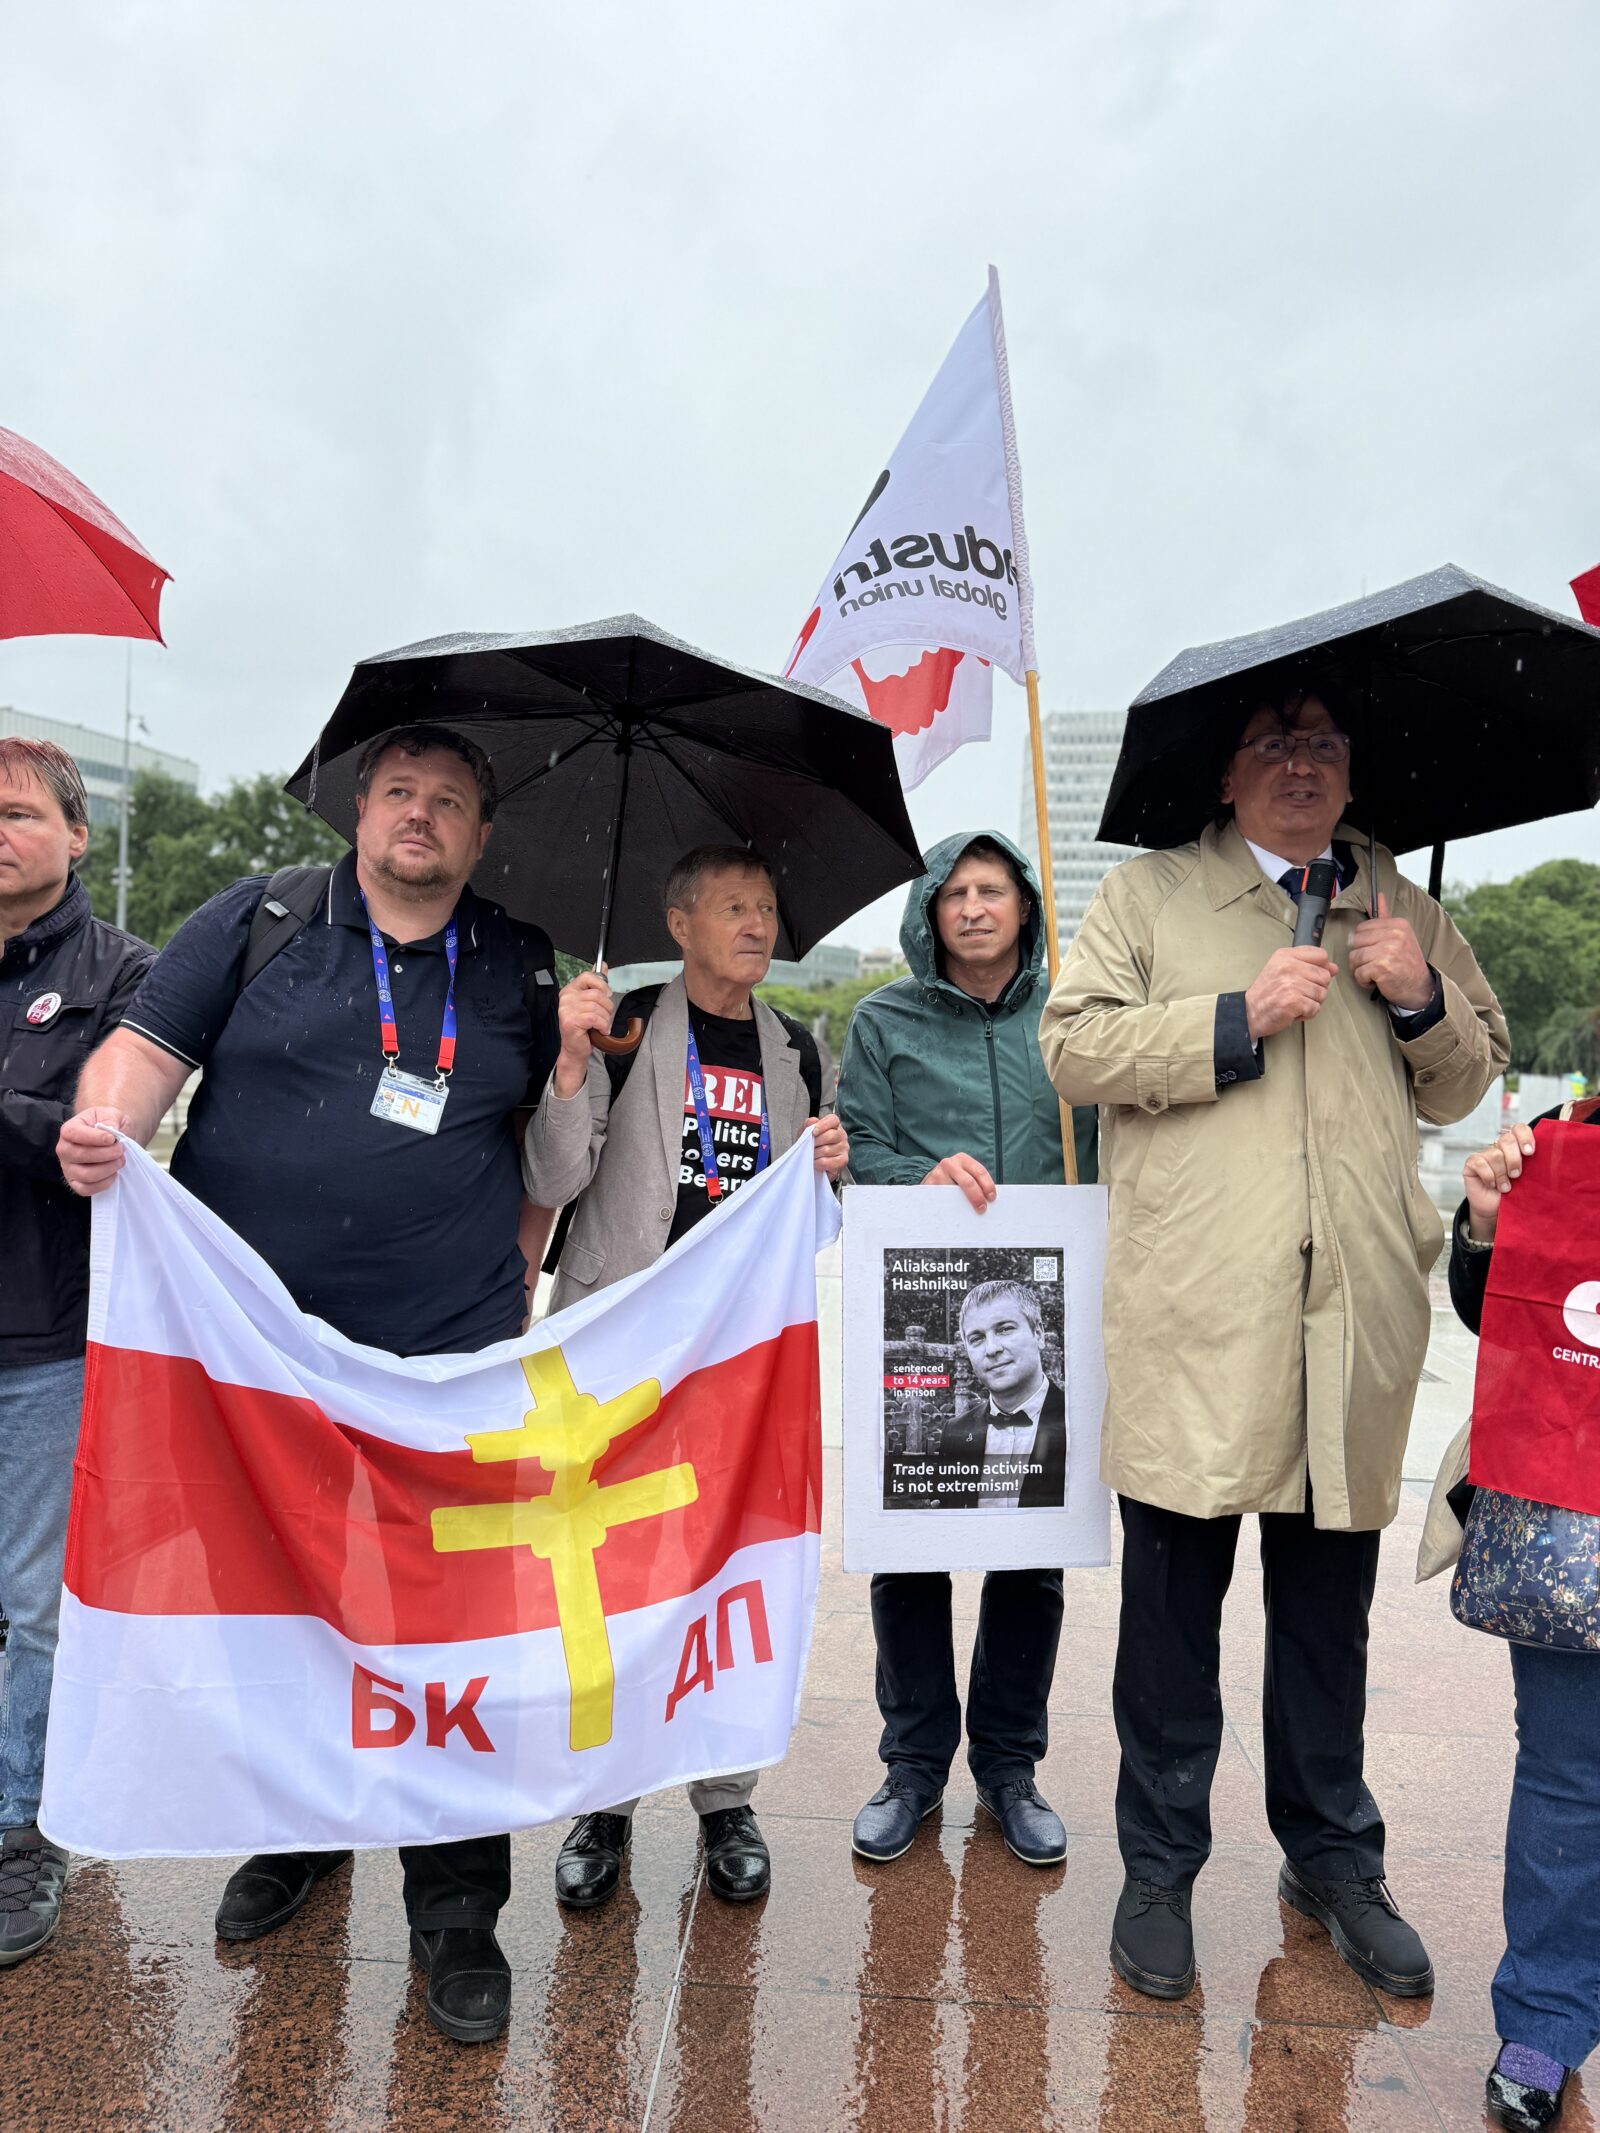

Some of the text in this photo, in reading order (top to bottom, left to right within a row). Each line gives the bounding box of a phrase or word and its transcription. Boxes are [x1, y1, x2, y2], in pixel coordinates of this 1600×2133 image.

[682, 1116, 760, 1147] Plitic
[892, 1259, 970, 1273] Aliaksandr
[892, 1277, 968, 1291] Hashnikau
[1552, 1346, 1600, 1369] CENTR
[893, 1363, 944, 1373] sentenced
[893, 1376, 947, 1387] to 14 years
[893, 1388, 936, 1398] in prison
[893, 1461, 1043, 1476] Trade union activism
[892, 1478, 1019, 1493] is not extremism!
[352, 1579, 774, 1753] БК ДП
